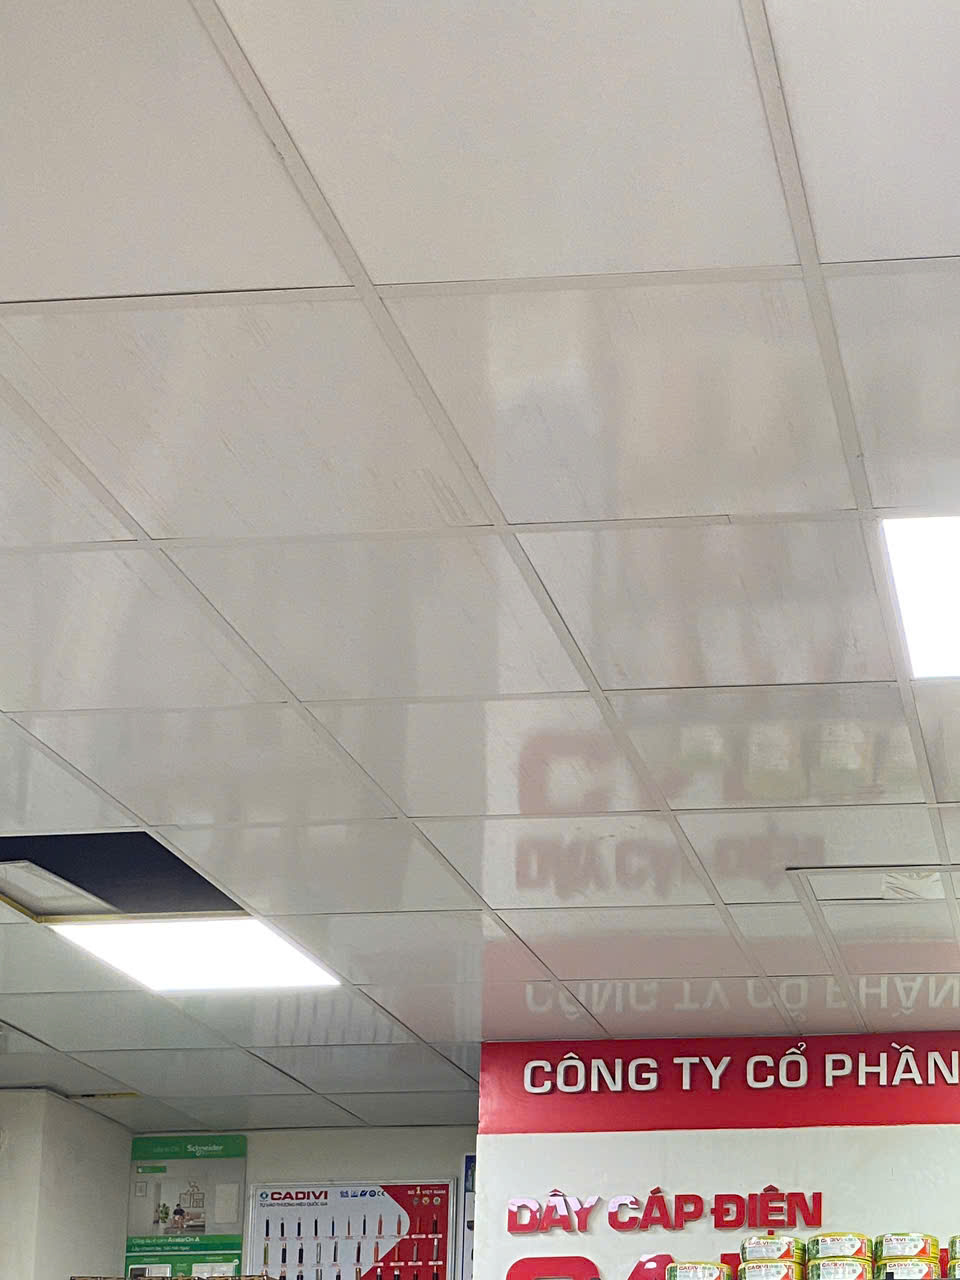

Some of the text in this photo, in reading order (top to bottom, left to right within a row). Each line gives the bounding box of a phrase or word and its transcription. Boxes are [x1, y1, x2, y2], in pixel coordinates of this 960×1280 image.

[523, 1053, 657, 1094] CÔNG
[673, 1056, 731, 1090] TY
[747, 1042, 807, 1088] CỔ
[825, 1042, 959, 1087] PHẦN
[187, 1144, 223, 1152] Schneider
[271, 1191, 328, 1200] CADIVI
[507, 1185, 822, 1235] DÂY CÁP ĐIỆN
